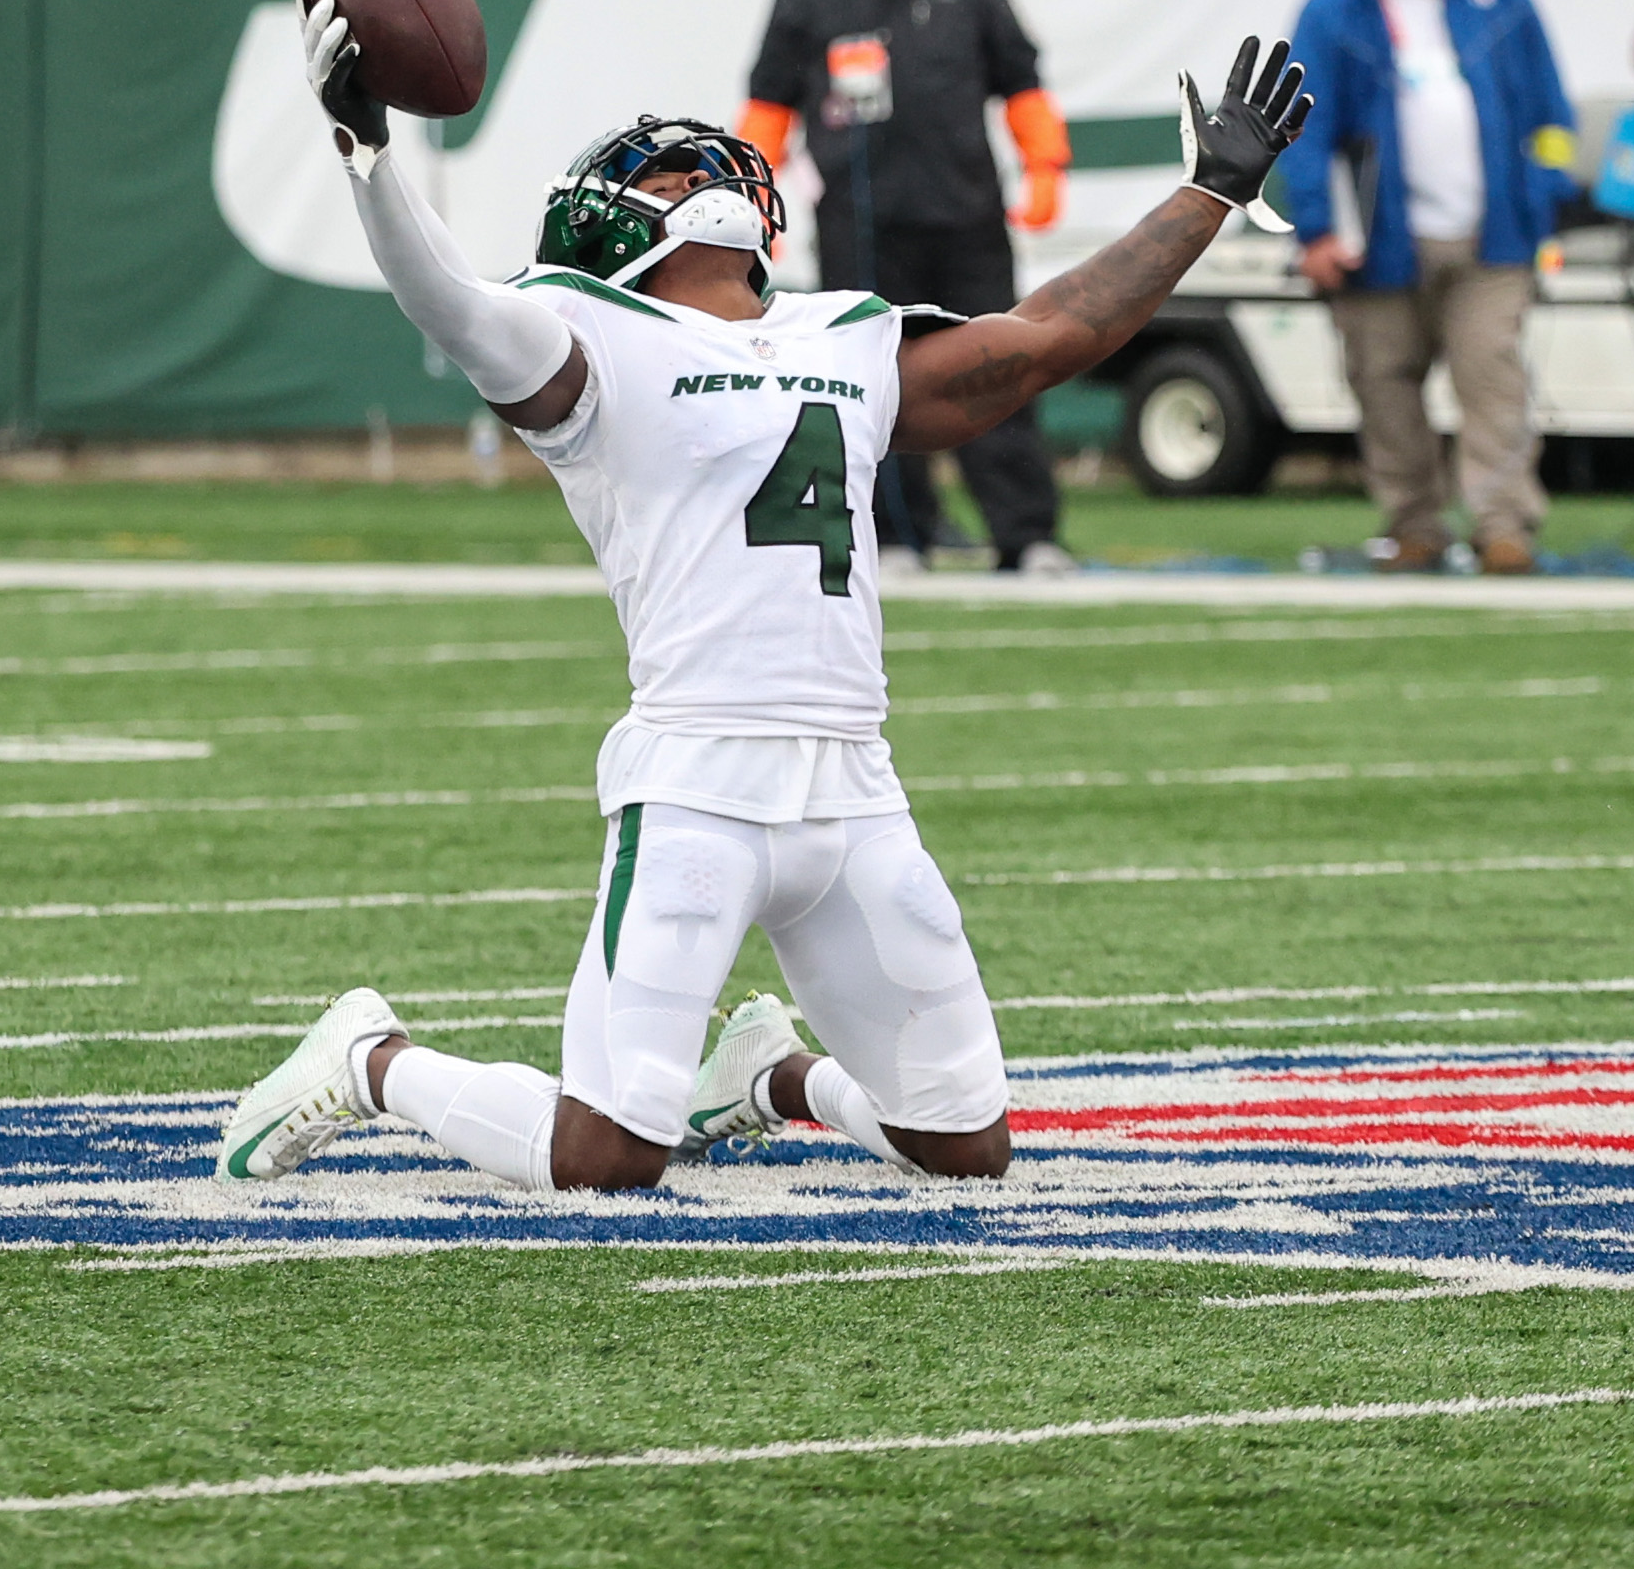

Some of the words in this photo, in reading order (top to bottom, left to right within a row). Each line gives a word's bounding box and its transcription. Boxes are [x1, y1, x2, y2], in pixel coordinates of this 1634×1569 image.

[671, 374, 766, 398] NEW
[776, 376, 866, 405] YORK
[745, 402, 857, 598] 4
